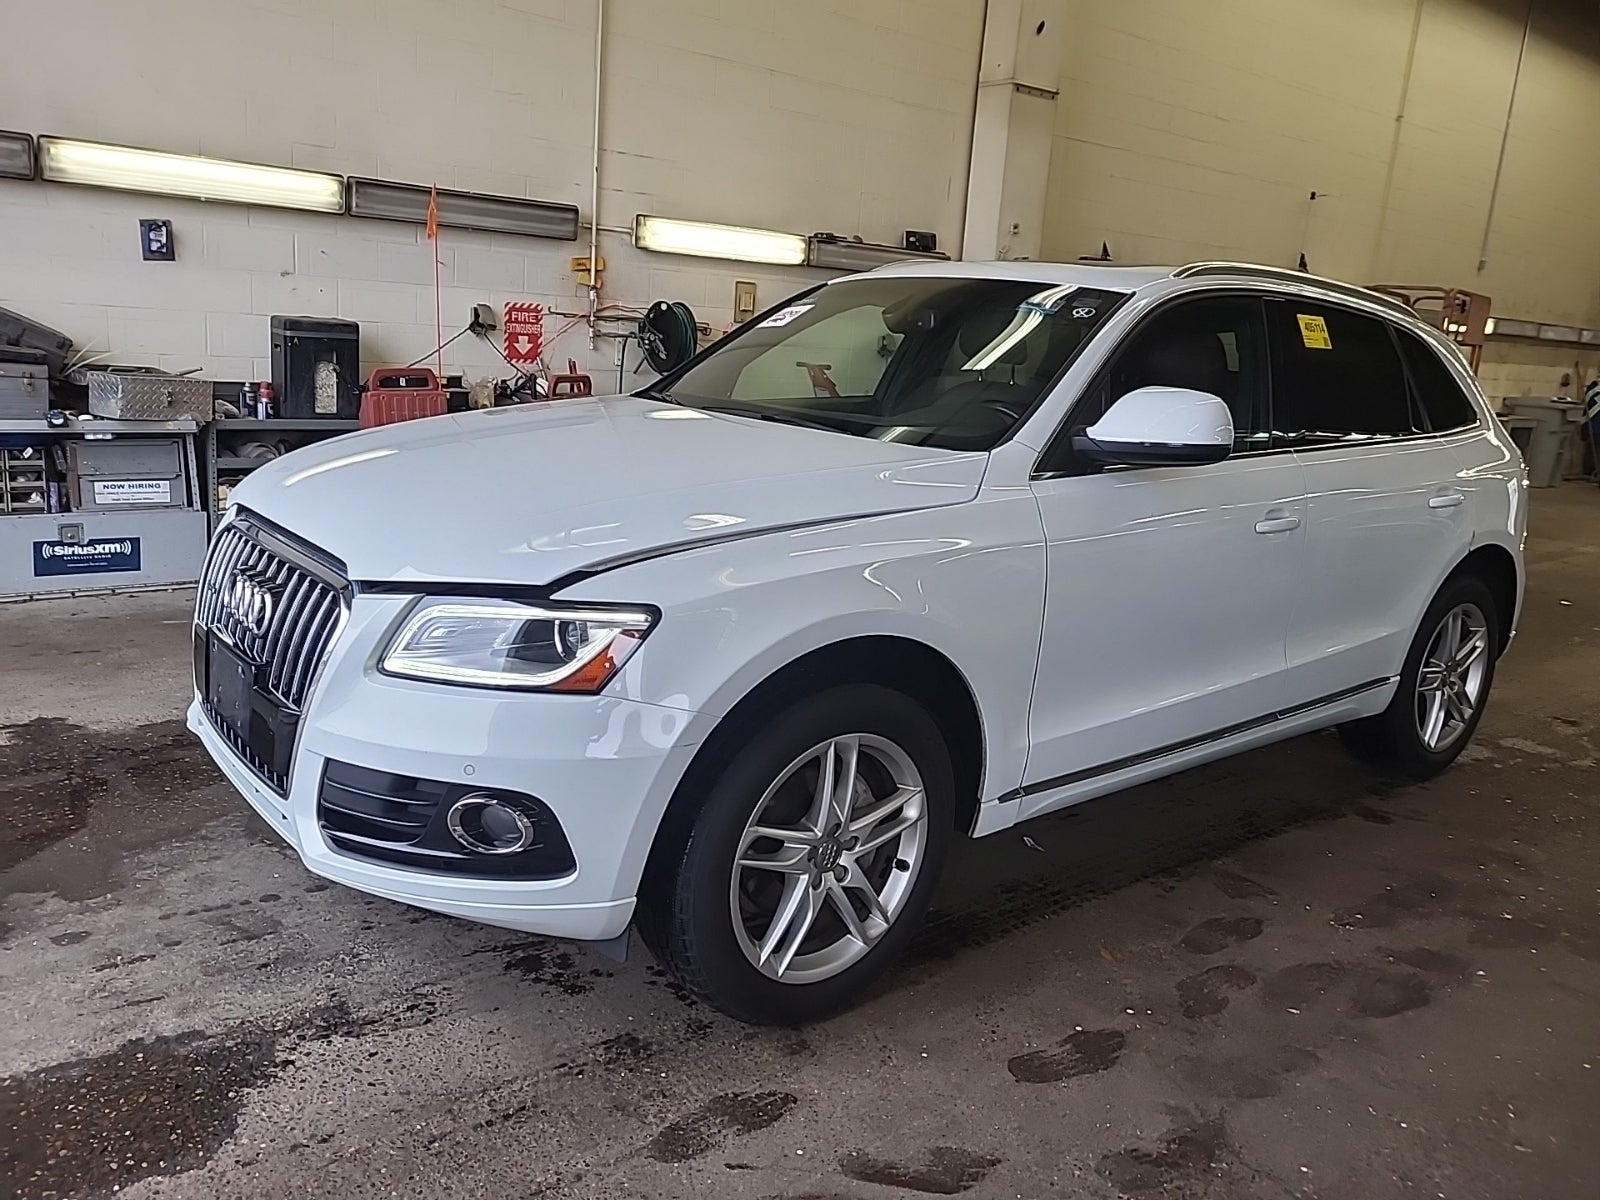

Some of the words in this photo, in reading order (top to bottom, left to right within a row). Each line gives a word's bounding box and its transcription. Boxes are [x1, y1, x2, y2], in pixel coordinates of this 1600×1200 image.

[511, 311, 537, 322] FIRE
[506, 323, 541, 334] EXTINGUISHER
[128, 482, 161, 490] HIRING
